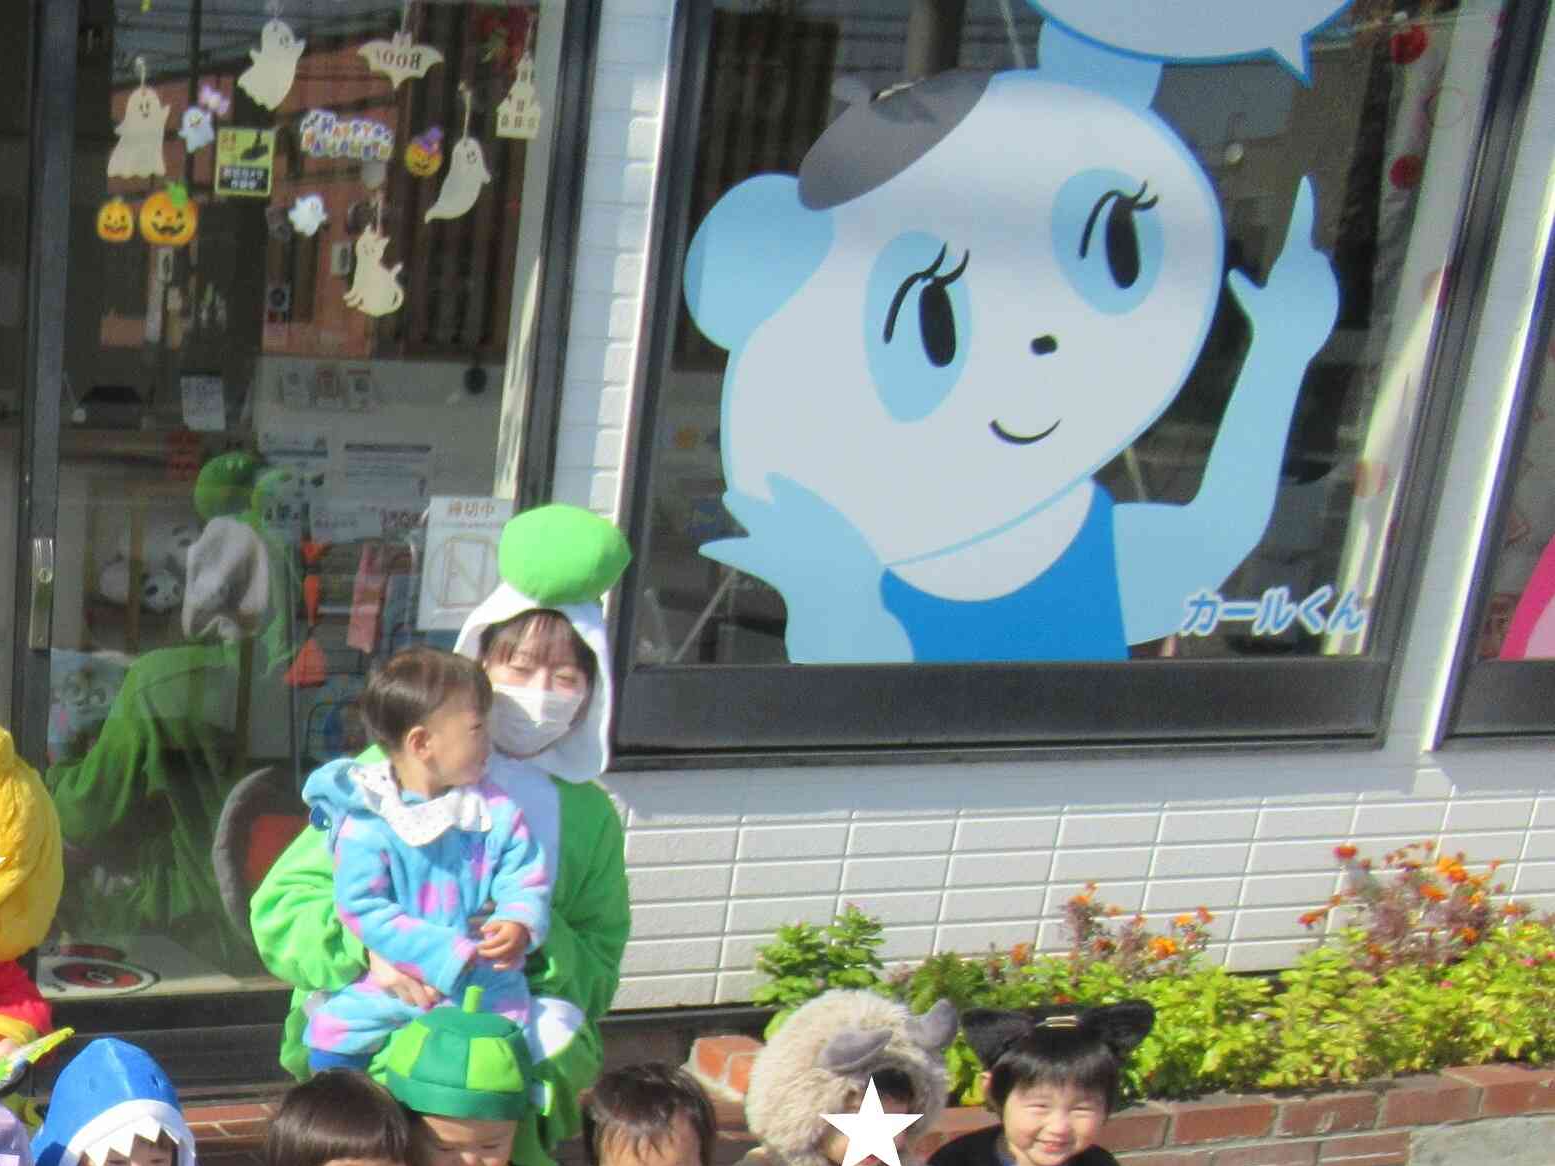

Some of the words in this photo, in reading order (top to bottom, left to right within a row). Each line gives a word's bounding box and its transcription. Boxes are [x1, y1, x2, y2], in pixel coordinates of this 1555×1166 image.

[1179, 584, 1370, 637] カールくん
